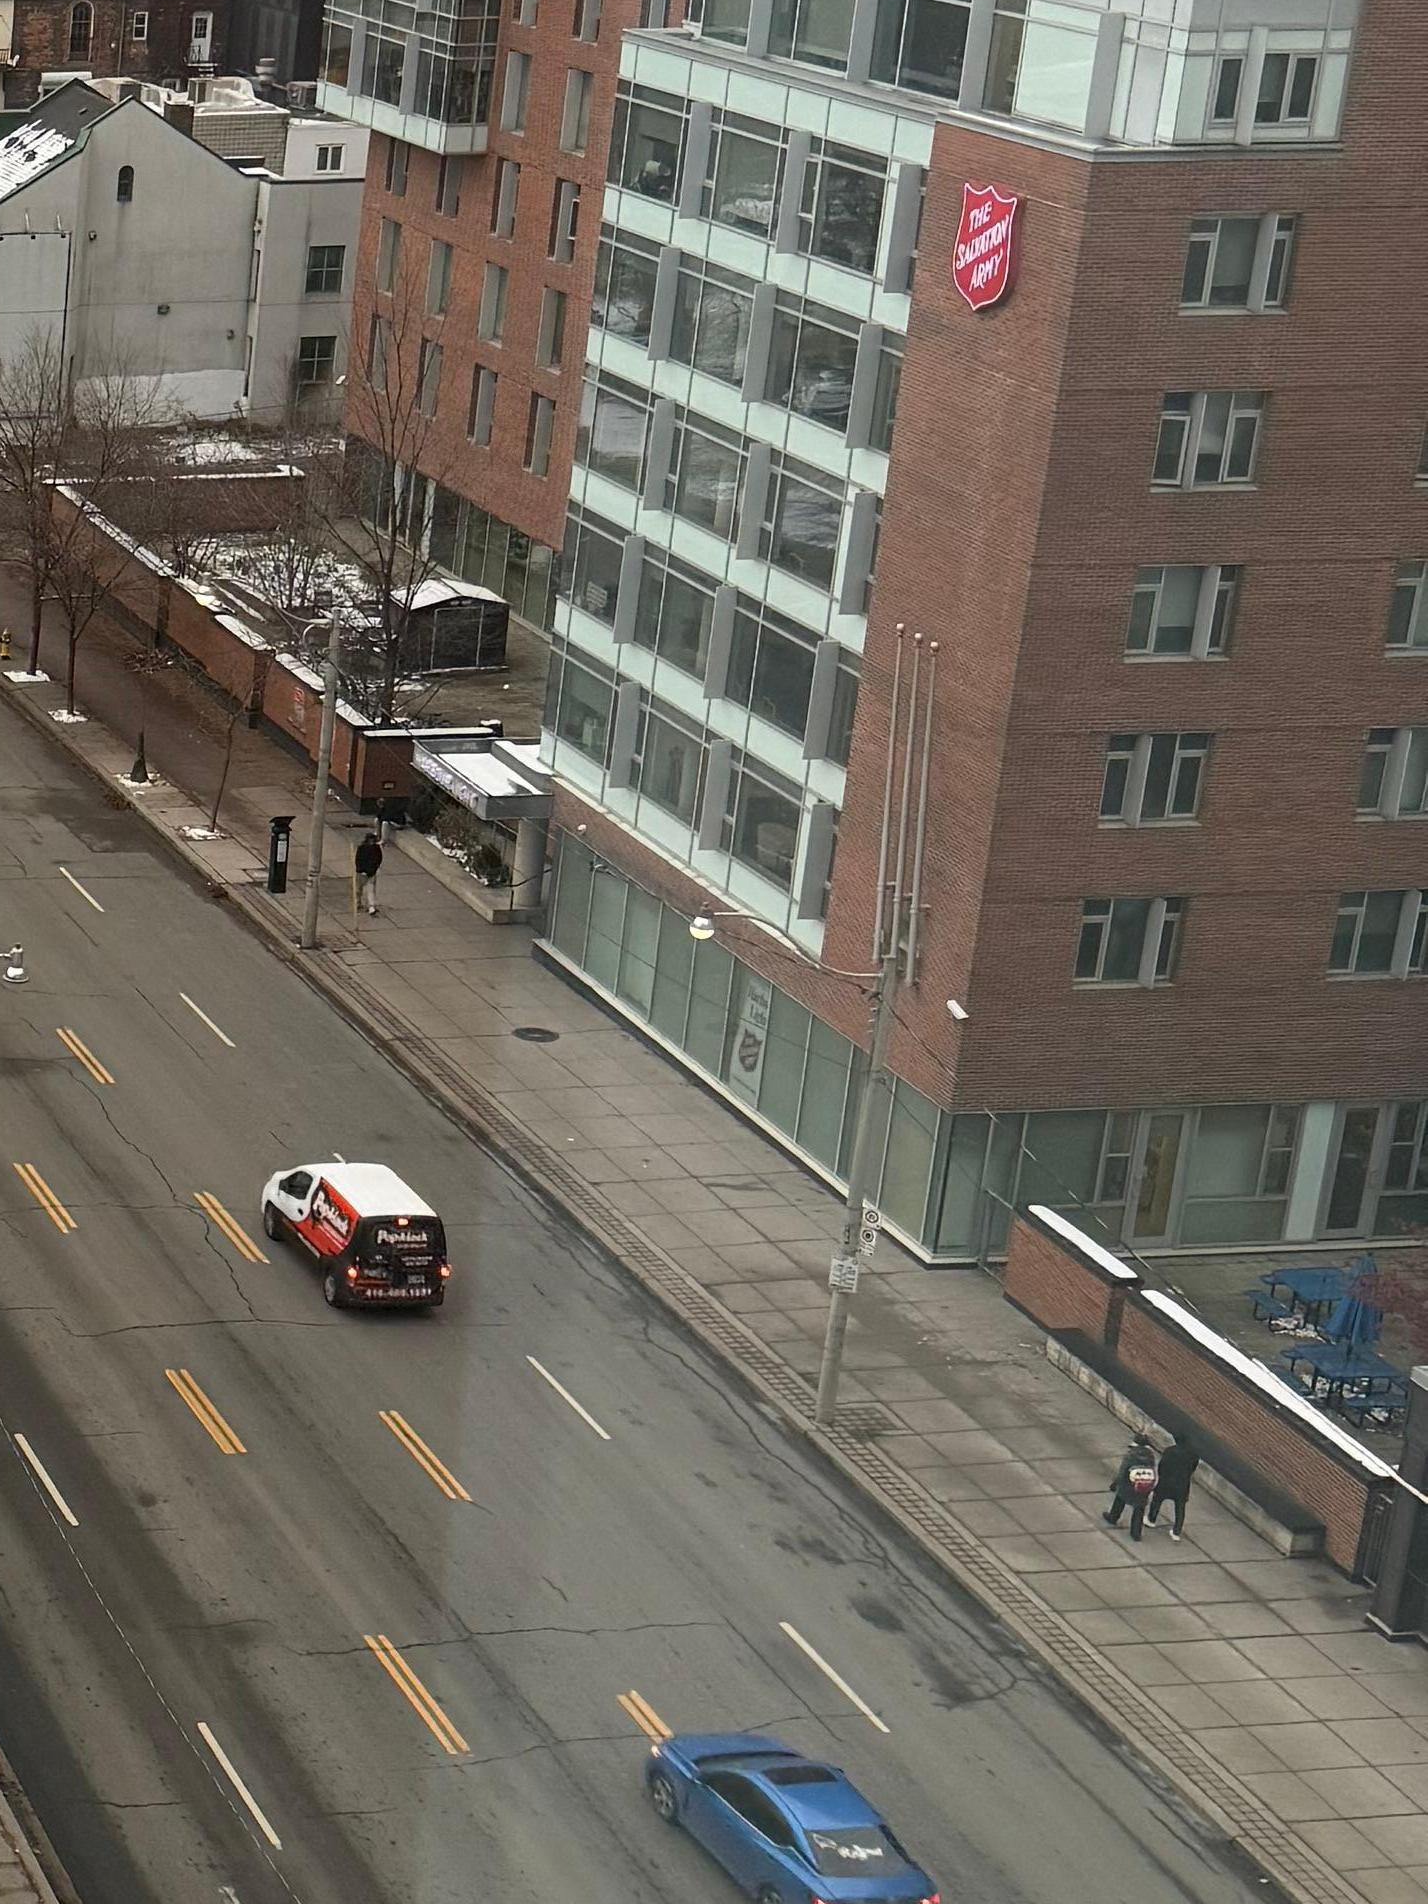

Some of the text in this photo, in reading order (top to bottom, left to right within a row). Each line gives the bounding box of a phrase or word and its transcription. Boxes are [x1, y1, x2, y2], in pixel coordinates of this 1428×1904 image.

[969, 200, 992, 233] THE
[956, 214, 1009, 270] SALVATION
[969, 248, 1003, 292] ARMY
